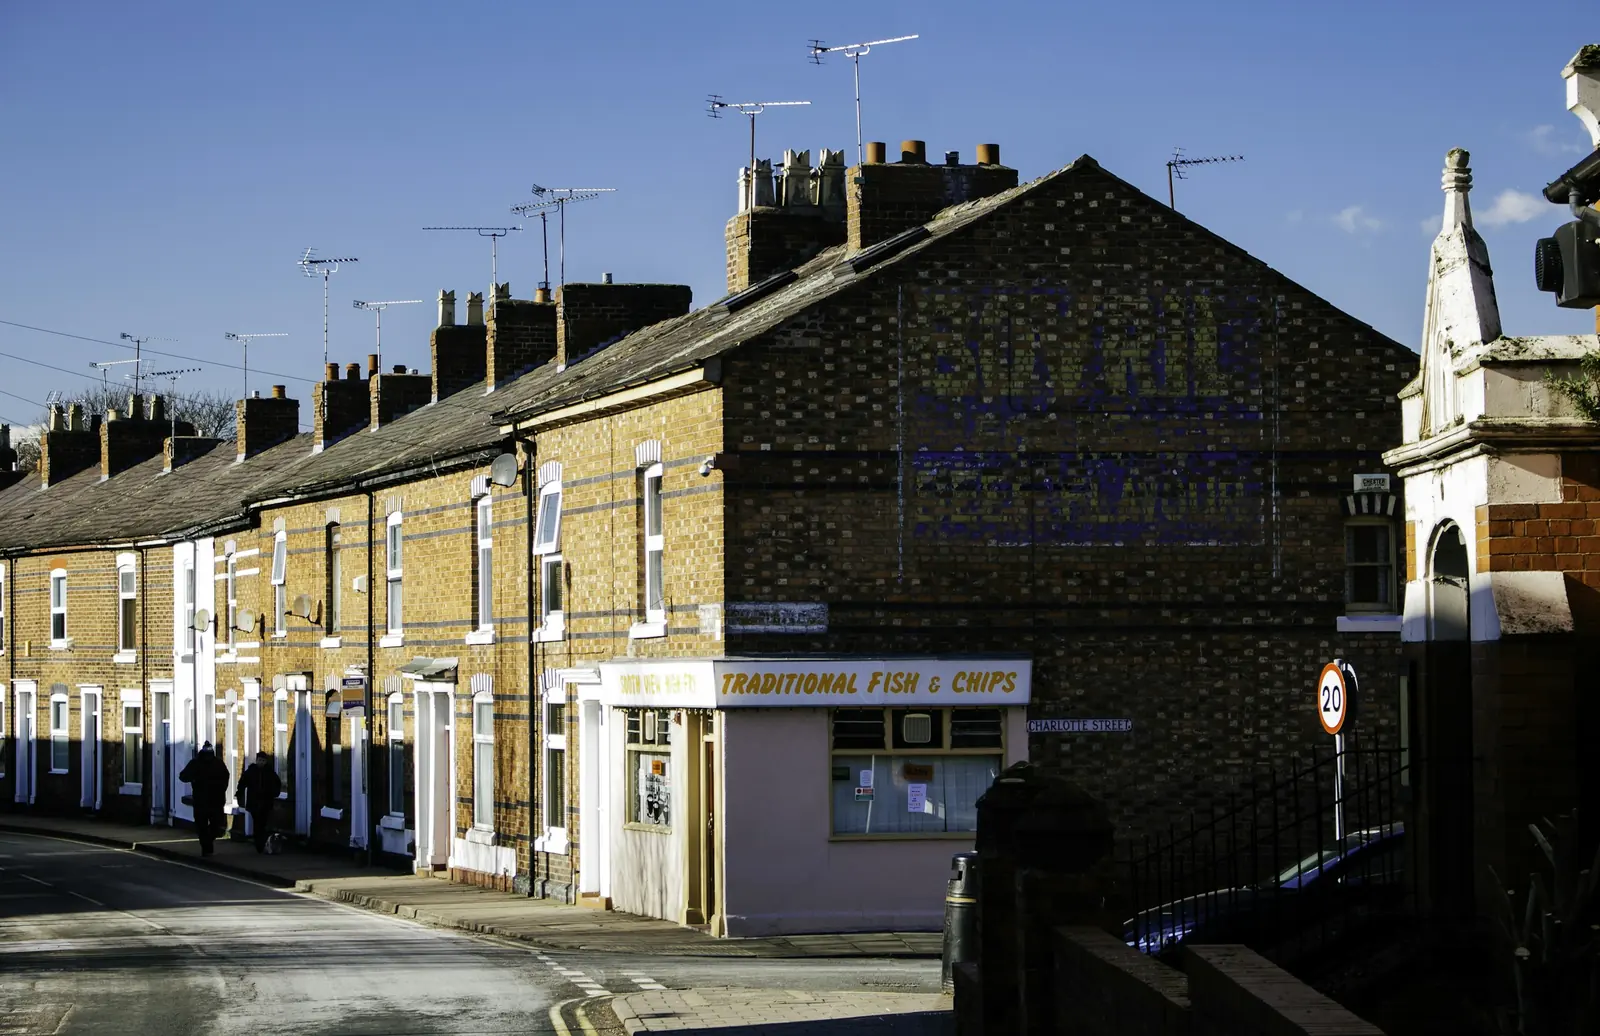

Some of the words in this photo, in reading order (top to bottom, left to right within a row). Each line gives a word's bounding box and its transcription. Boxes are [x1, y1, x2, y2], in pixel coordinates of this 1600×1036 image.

[721, 673, 857, 695] TRADITIONAL
[867, 672, 920, 694] FISH
[929, 676, 941, 693] &
[951, 671, 1017, 694] CHIPS
[1322, 685, 1341, 712] 20
[1028, 719, 1088, 732] CHARLOTTE
[1092, 719, 1129, 731] STREET
